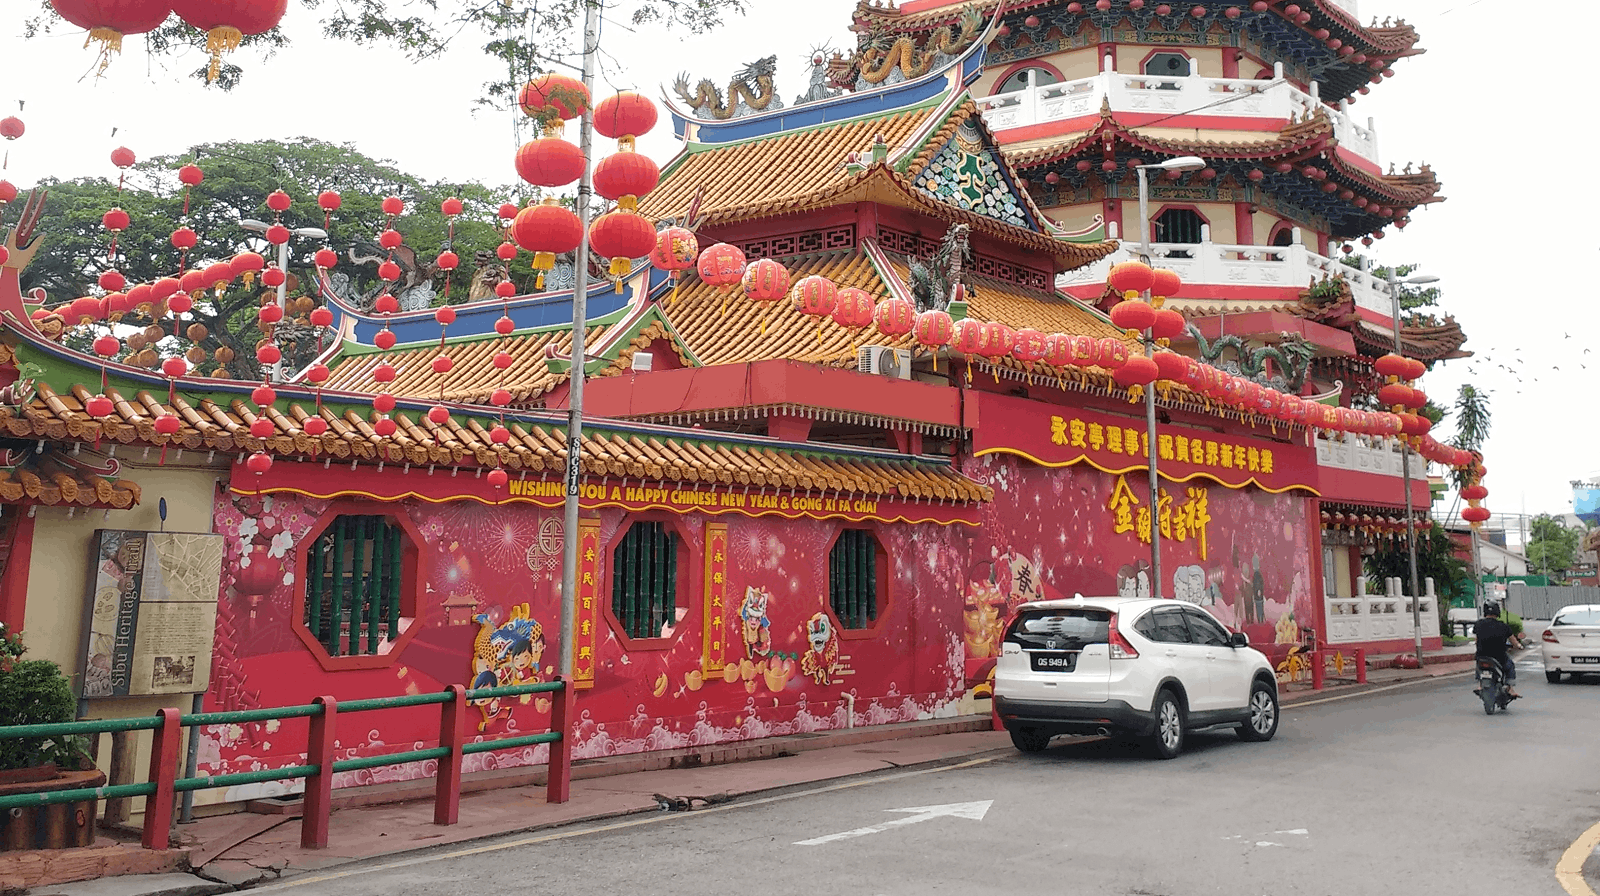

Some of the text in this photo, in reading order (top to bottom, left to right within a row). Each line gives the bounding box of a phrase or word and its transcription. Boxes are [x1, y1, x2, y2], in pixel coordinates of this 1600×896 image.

[579, 484, 607, 500] YOU
[611, 486, 622, 501] A
[626, 487, 669, 502] HAPPY
[671, 490, 718, 506] CHINESE
[721, 493, 746, 507] NEW
[750, 494, 778, 509] YEAR
[780, 496, 790, 510] &
[792, 497, 823, 511] GONG
[825, 499, 836, 512] XI
[839, 500, 851, 512] FA
[854, 501, 877, 514] CHAI
[1014, 563, 1034, 596] 春
[112, 539, 141, 687] Sibu Heritage Trail
